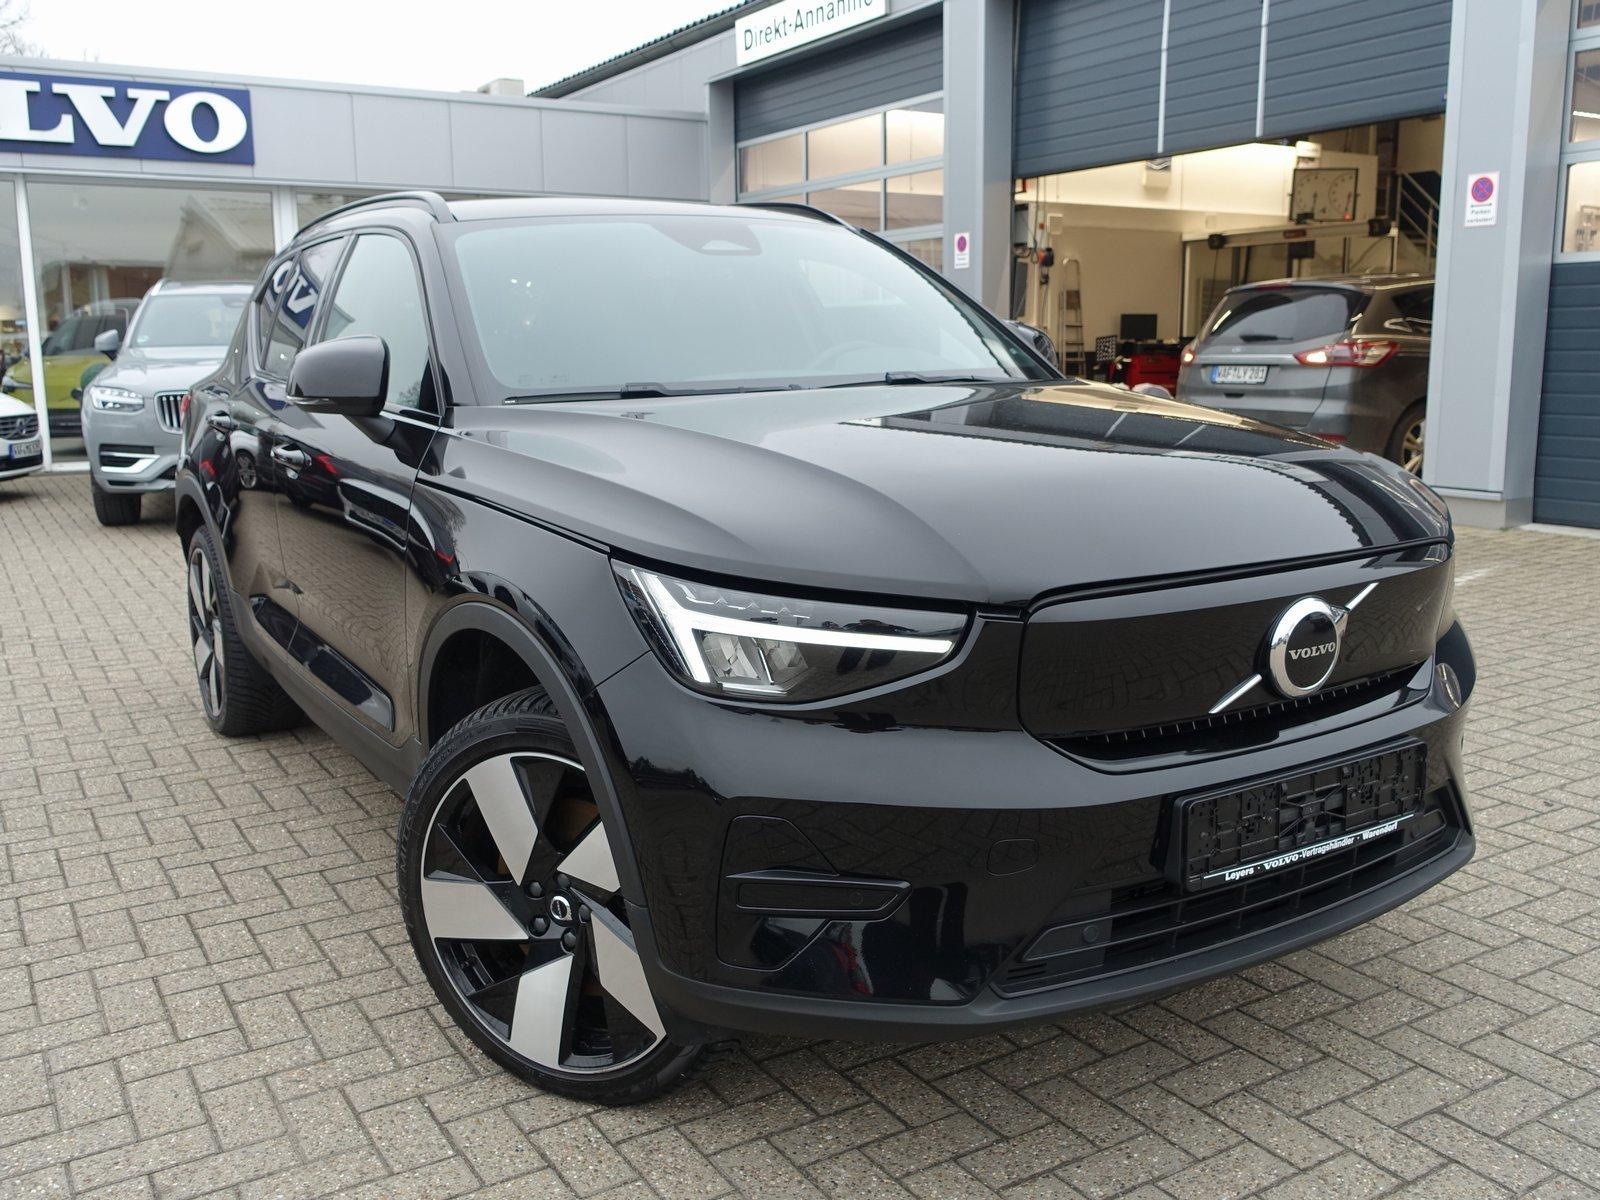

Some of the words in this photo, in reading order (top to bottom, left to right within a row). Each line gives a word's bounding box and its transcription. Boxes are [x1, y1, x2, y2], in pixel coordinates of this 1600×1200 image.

[1288, 641, 1336, 660] VOLVO
[1225, 867, 1254, 881] Leyers
[1362, 820, 1398, 840] Warendorf
